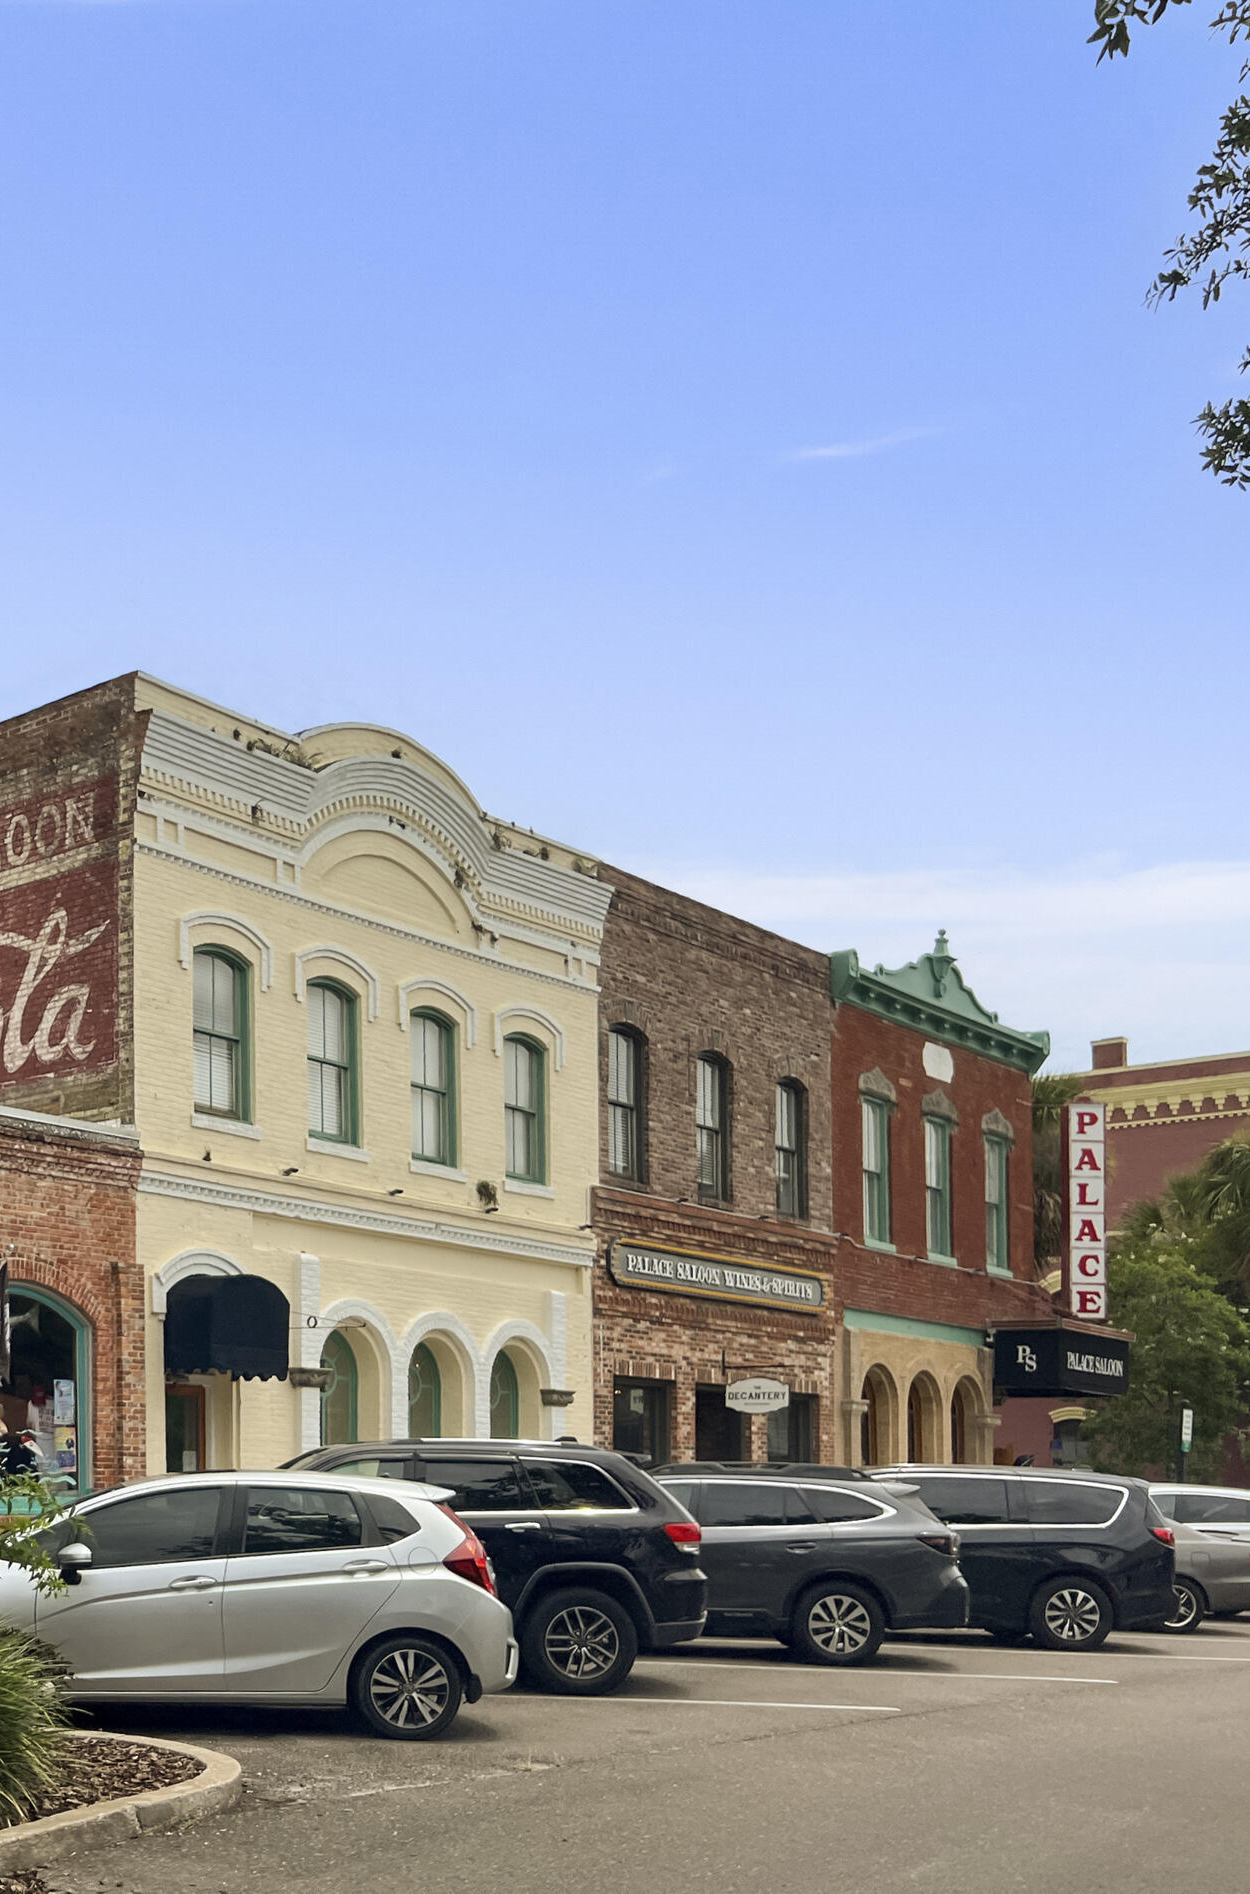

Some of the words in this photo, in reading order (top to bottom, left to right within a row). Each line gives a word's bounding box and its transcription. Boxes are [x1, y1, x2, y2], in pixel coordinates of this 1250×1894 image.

[1075, 1112, 1101, 1313] PALACE
[626, 1253, 674, 1278] PALACE
[677, 1261, 720, 1285] SALOON
[723, 1269, 760, 1292] WINES
[762, 1277, 772, 1293] &
[771, 1279, 813, 1299] SPIRITS
[1066, 1351, 1095, 1373] PALACE
[1095, 1356, 1124, 1377] SALOON
[728, 1391, 786, 1400] DECANTERY
